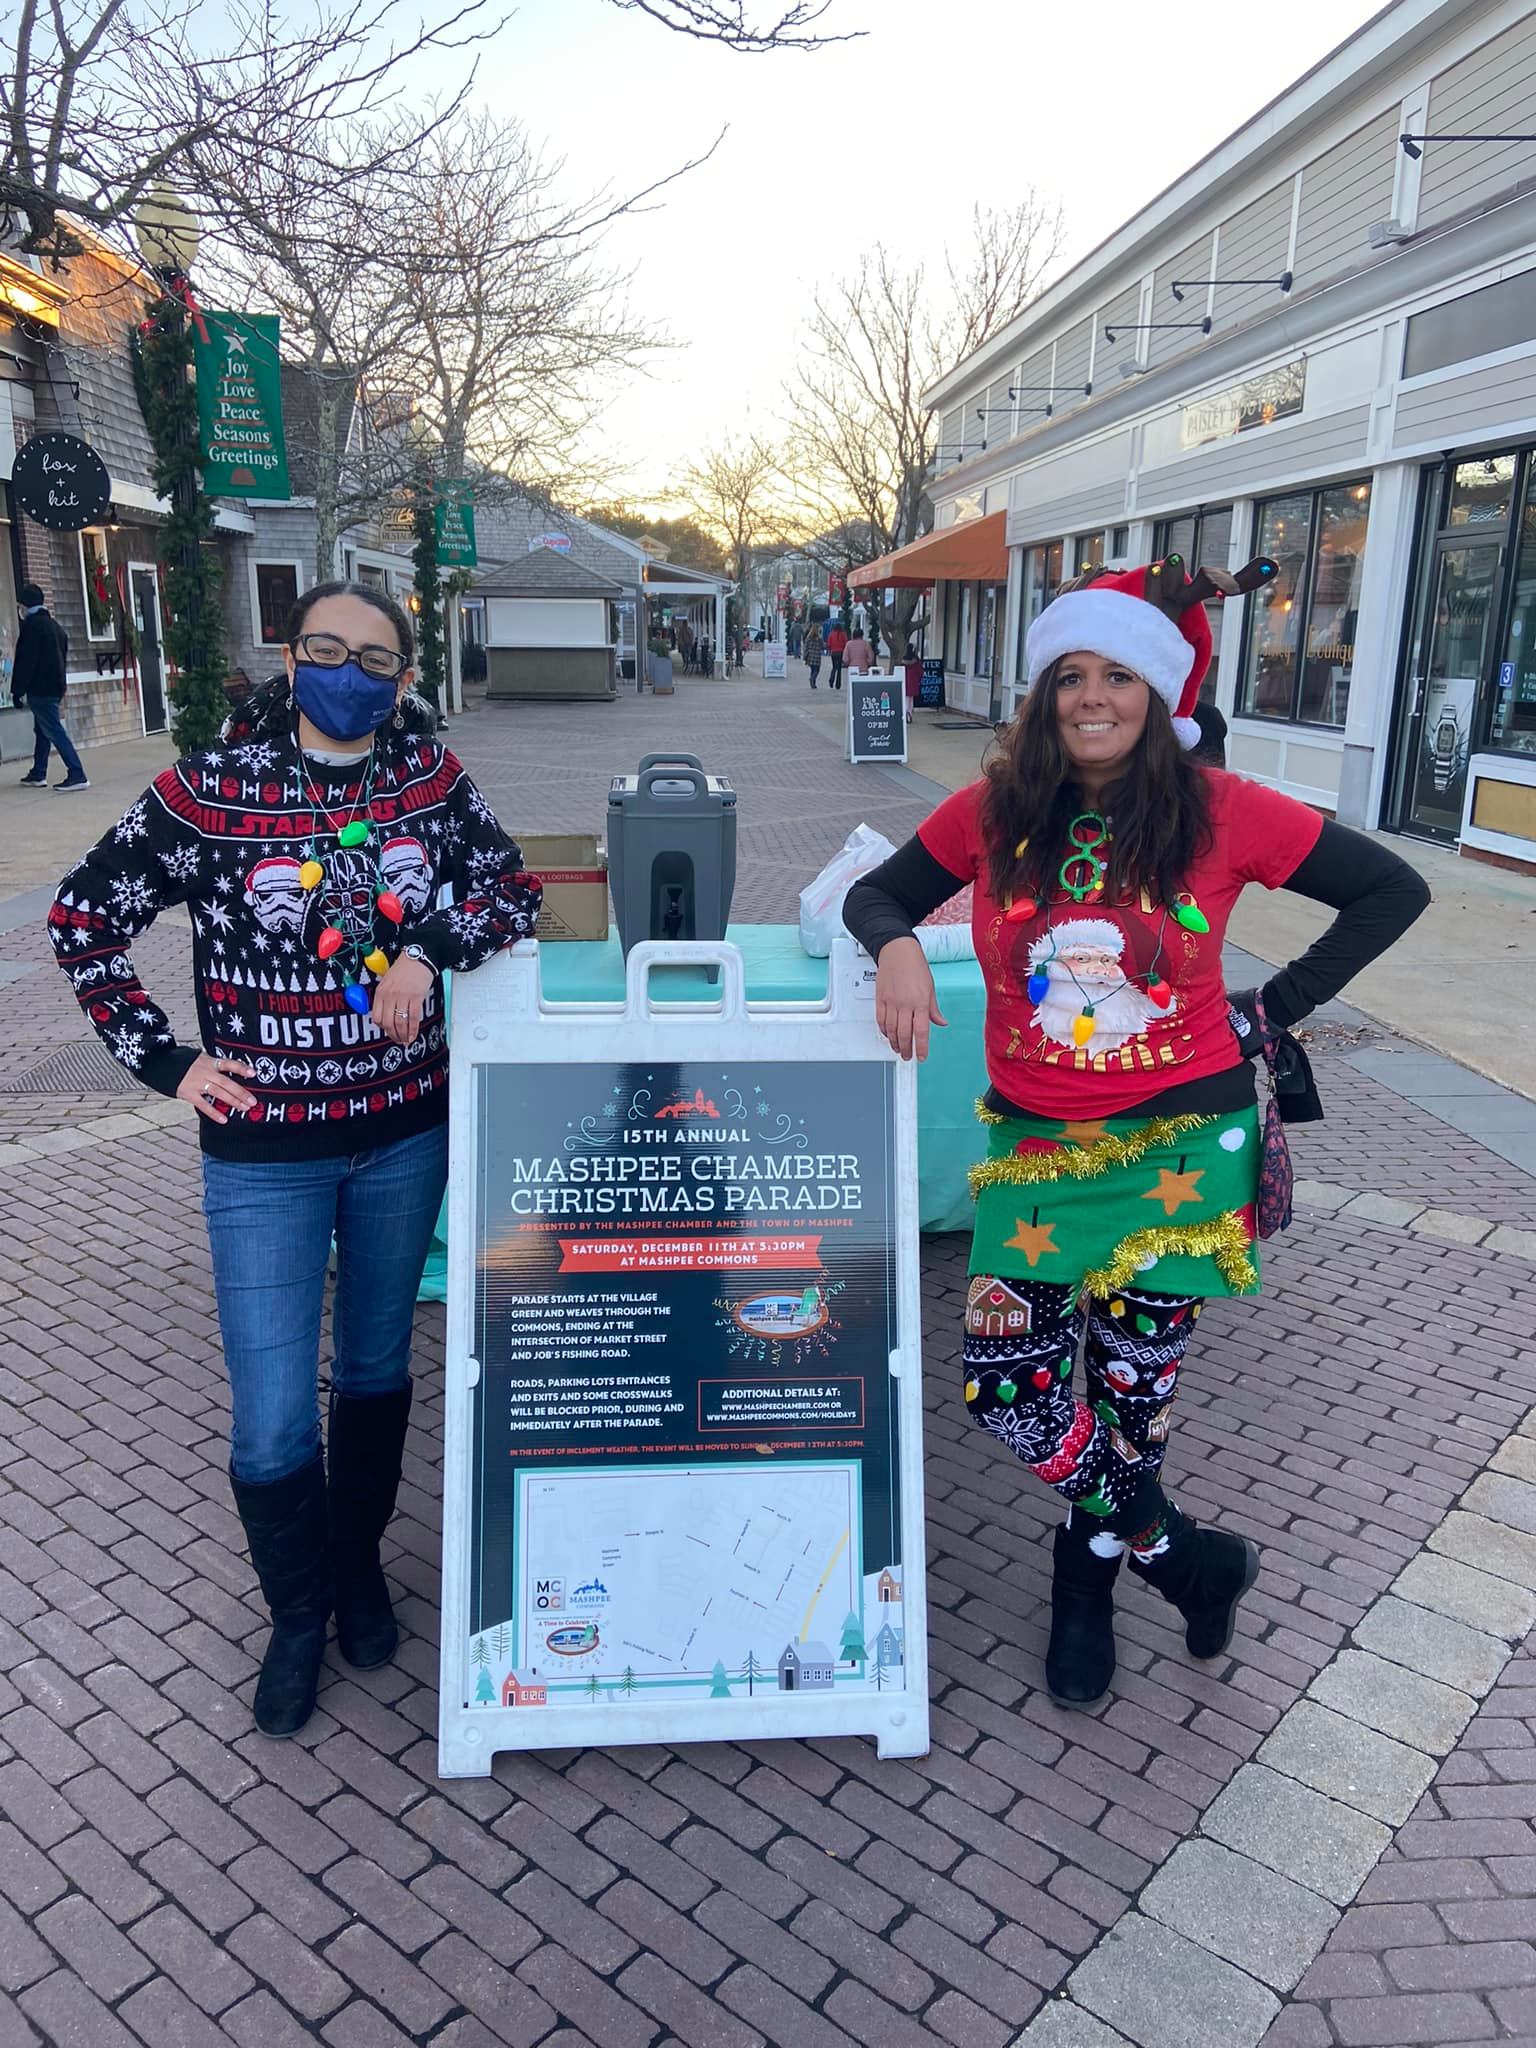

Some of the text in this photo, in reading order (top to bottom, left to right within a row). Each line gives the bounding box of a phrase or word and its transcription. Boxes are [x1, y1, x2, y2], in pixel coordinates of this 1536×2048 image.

[226, 358, 249, 378] Joy
[223, 381, 255, 398] Love
[220, 403, 260, 420] Peace
[214, 424, 270, 443] Seasons
[42, 453, 77, 474] fox
[208, 446, 279, 470] Greetings
[48, 490, 80, 506] kit
[232, 814, 321, 836] STAR
[258, 992, 348, 1014] I FIND YOUR
[260, 986, 434, 1048] DISTURG
[624, 1128, 750, 1144] 15TH ANNUAL
[512, 1154, 860, 1184] MASHPEE CHAMBER
[511, 1185, 862, 1214] CHRISTMAS PARADE
[519, 1218, 853, 1231] PRESENTED BY THE MASHPEE CHAMBER AND THE TOWN OF MASHPEE
[572, 1241, 805, 1255] SATURDAY, DECEMBER 11TH AT 5:30PM
[620, 1254, 758, 1266] AT MASHPEE COMMONS
[512, 1293, 658, 1304] PARADE STARTS AT THE VILLAGE
[512, 1307, 671, 1319] GREEN AND WEAVES THROUGH THE
[512, 1321, 634, 1332] COMMONS, ENDING AT THE
[512, 1335, 667, 1346] INTERSECTION OF MARKET STREET
[512, 1349, 631, 1360] AND JOB'S FISHING ROAD.
[511, 1376, 670, 1388] ROADS, PARKING LOTS ENTRANCES
[511, 1390, 672, 1402] AND EXITS AND SOME CROSSWALKS
[722, 1388, 841, 1399] ADDITIONAL DETAILS AT:
[511, 1404, 684, 1416] WILL BE BLOCKED PRIOR, DURING AND
[722, 1402, 829, 1411] WWW.MASHPEECHAMBER.COM
[707, 1411, 856, 1421] WWW.MASHPEECOMMONS.COM/HOLIDAYS
[510, 1418, 663, 1430] IMMEDIATELY AFTER THE PARADE.
[567, 1447, 604, 1455] INCLEMENT
[569, 1595, 611, 1603] MASHPEE
